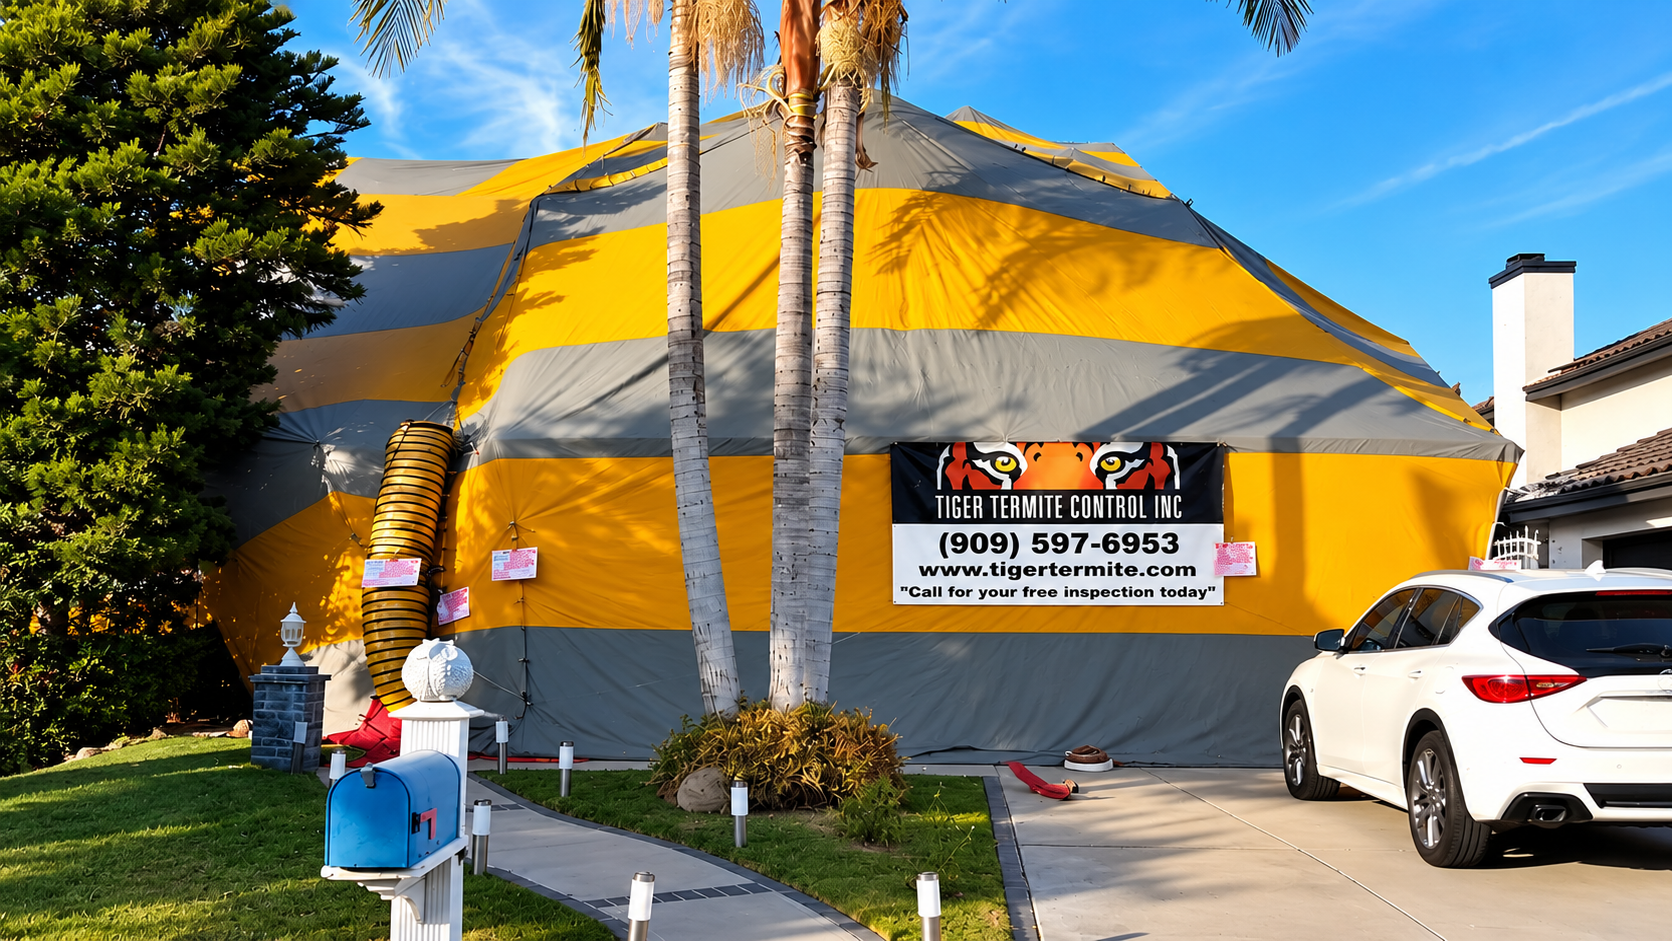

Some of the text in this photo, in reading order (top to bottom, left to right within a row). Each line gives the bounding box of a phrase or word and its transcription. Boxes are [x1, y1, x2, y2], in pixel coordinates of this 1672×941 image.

[935, 495, 1181, 518] TIGER TERMITE CONTROL INC
[940, 532, 1179, 559] (909) 597-6953
[919, 562, 1196, 580] www.tigertermite.com
[900, 586, 1216, 600] "Call for your free inspection today"
